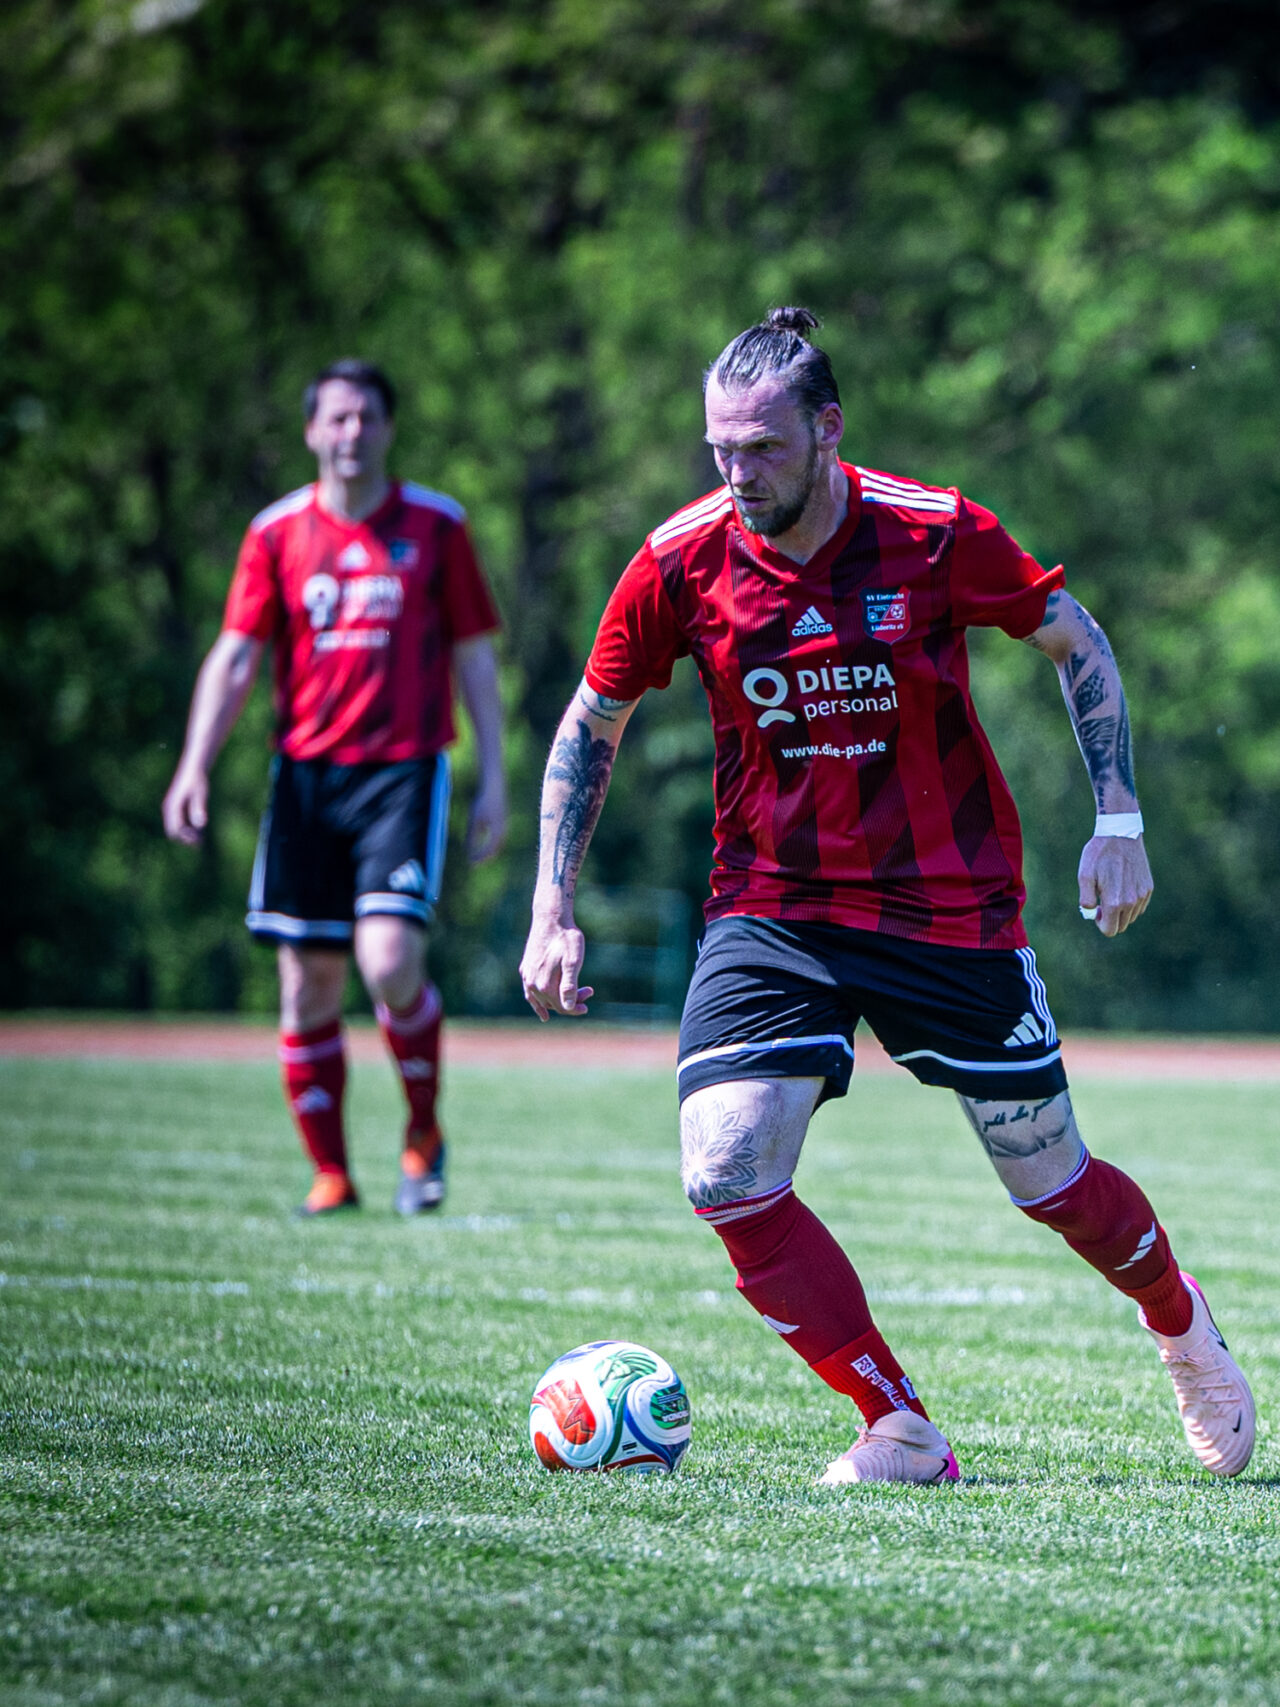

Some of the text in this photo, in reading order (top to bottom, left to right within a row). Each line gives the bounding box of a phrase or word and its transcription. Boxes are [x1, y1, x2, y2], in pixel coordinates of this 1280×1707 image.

[792, 622, 833, 637] adidas
[803, 690, 899, 722] personal
[781, 738, 887, 760] www.die-pa.de
